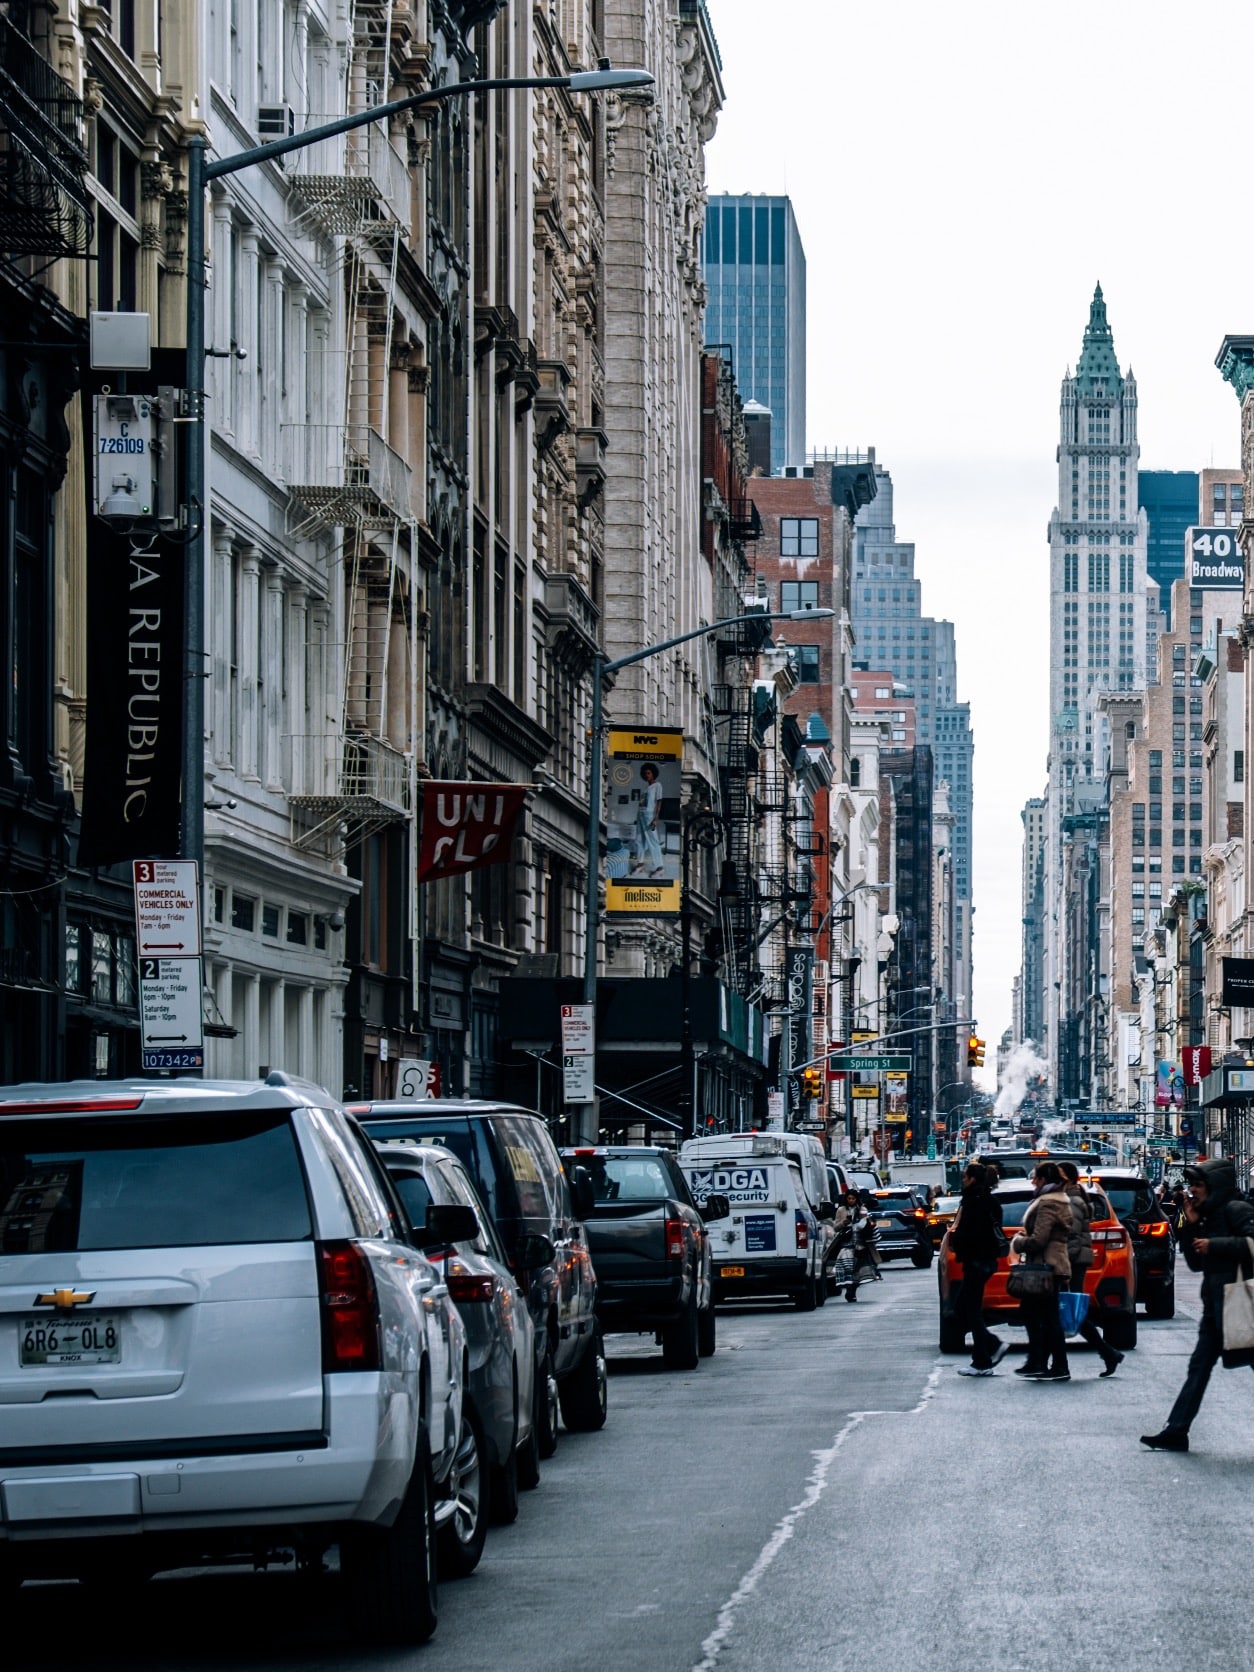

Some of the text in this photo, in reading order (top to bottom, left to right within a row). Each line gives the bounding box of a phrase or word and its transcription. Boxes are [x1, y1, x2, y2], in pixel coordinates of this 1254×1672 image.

[120, 422, 128, 438] C
[1193, 533, 1243, 556] 401
[1193, 561, 1244, 582] Broadway
[124, 608, 161, 823] REPUBLIC
[633, 735, 658, 745] NYC
[437, 793, 504, 827] UNI
[139, 864, 150, 882] 3
[138, 890, 186, 899] COMMERCIAL
[624, 889, 661, 902] melissa
[139, 901, 194, 909] VEHICLES ONLY
[167, 914, 185, 922] Friday
[157, 922, 171, 930] 6pm
[145, 960, 155, 978] 2
[170, 984, 188, 992] Friday
[144, 1005, 170, 1013] Saturday
[564, 1007, 571, 1017] 3
[145, 1055, 189, 1066] 107342
[566, 1057, 572, 1067] 2
[850, 1059, 879, 1069] Spring
[713, 1170, 766, 1190] DGA
[24, 1329, 58, 1352] 6R6
